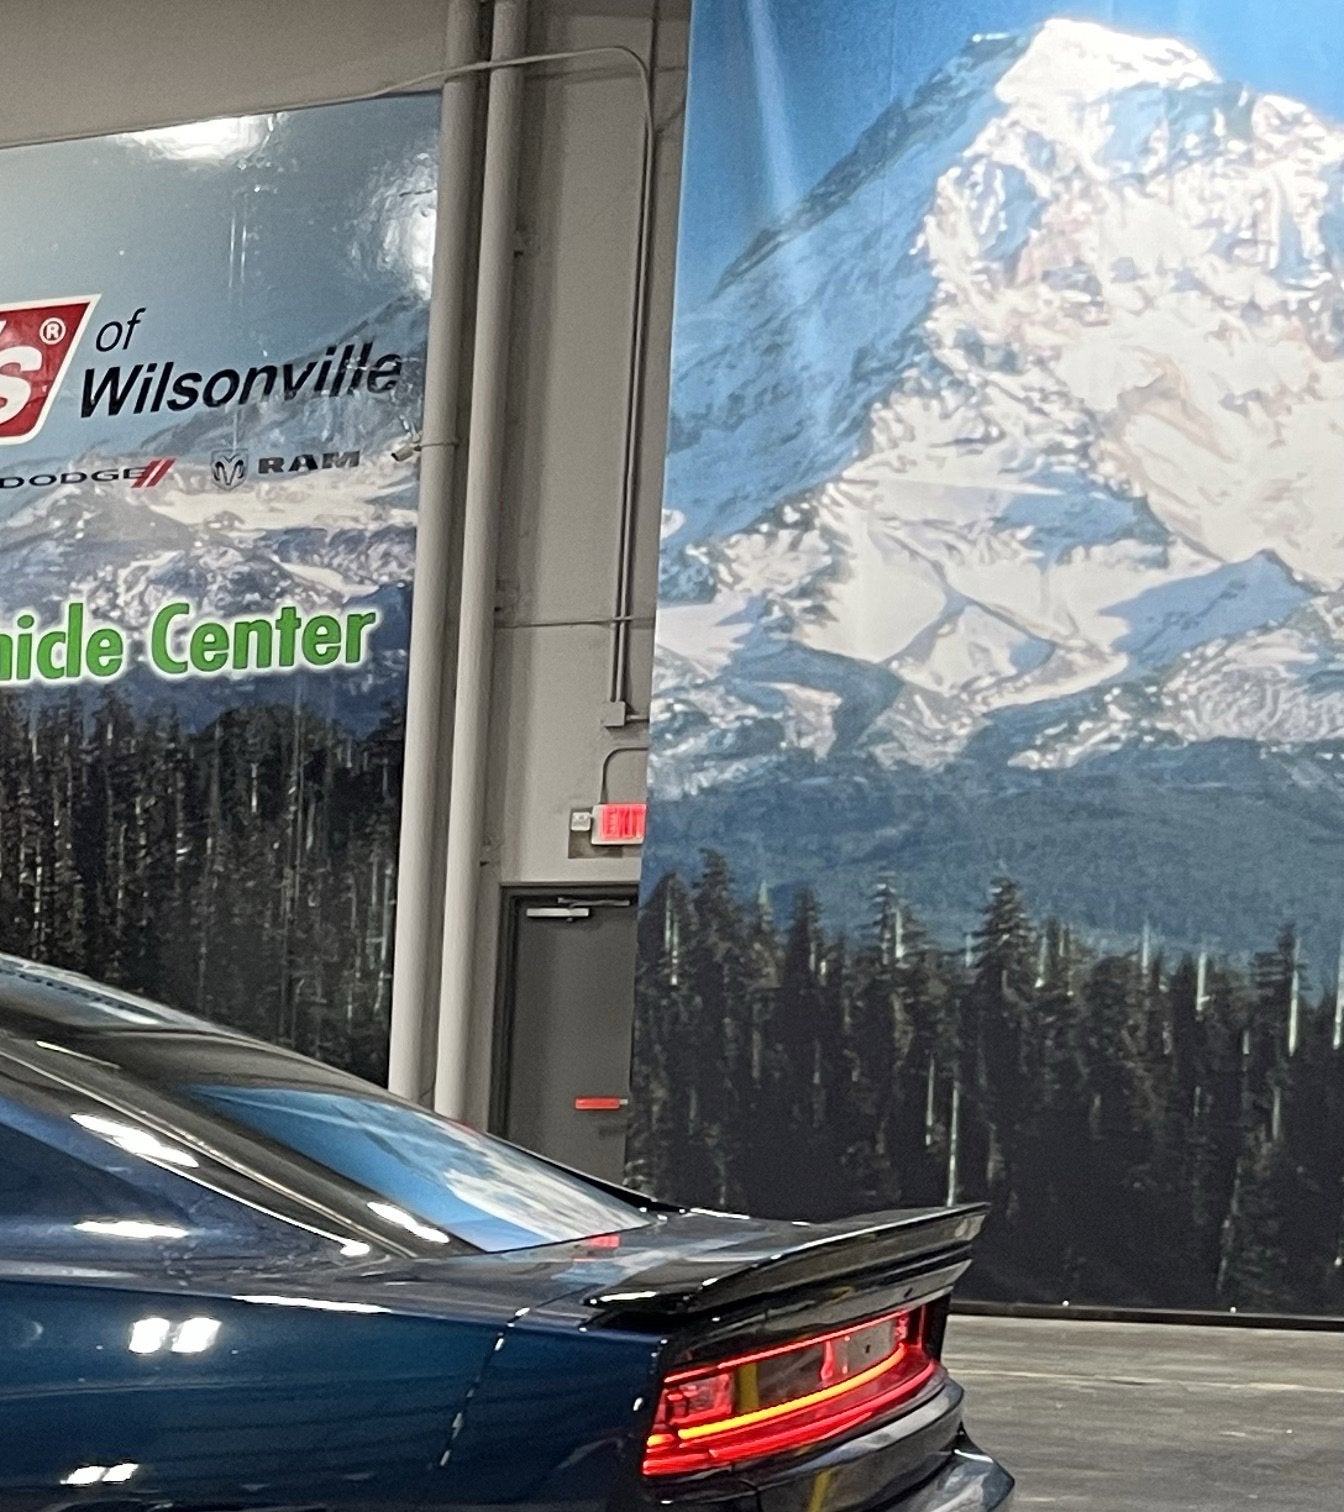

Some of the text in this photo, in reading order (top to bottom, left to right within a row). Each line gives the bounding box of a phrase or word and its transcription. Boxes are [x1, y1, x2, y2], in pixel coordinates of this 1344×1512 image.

[95, 307, 146, 353] of
[80, 341, 402, 419] Wilsonville
[258, 450, 361, 474] RAM
[150, 601, 377, 675] Center
